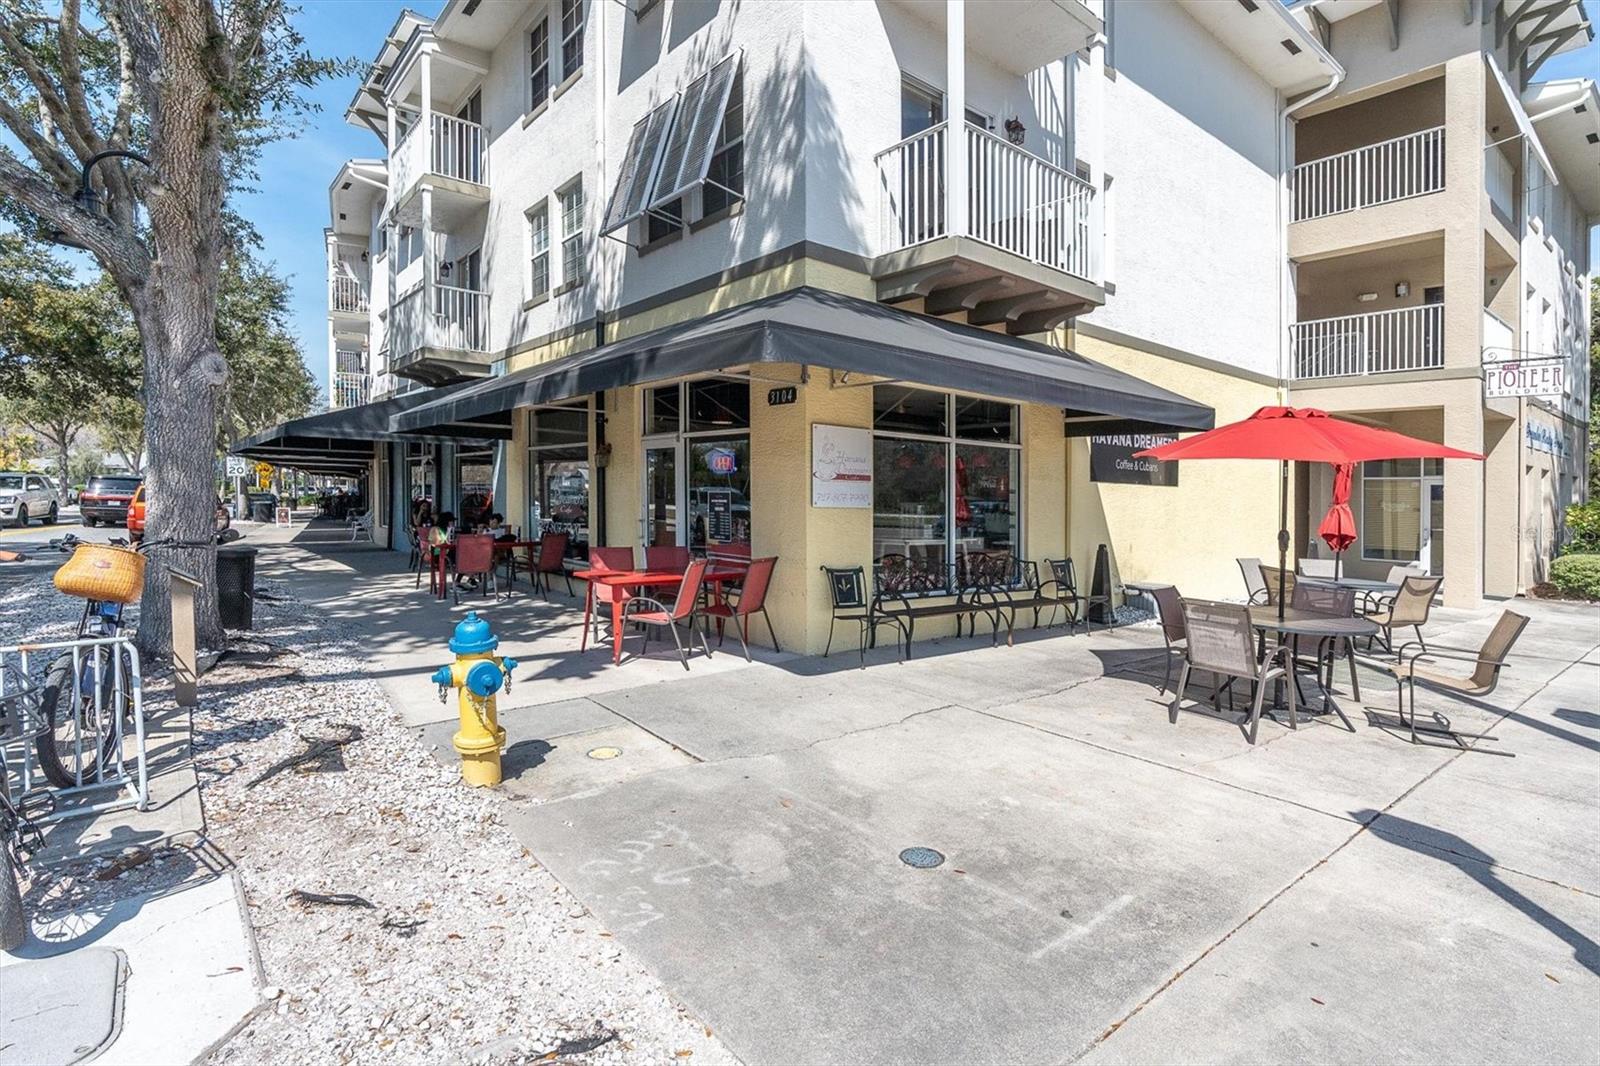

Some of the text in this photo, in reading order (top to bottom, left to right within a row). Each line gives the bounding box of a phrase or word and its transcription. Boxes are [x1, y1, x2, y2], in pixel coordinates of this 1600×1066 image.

[1488, 367, 1561, 390] PIONEER
[770, 389, 793, 403] 3104
[1489, 387, 1560, 395] BUILDING
[1134, 434, 1176, 448] DREAM
[229, 466, 244, 474] 20
[1115, 459, 1133, 470] Coffee
[1134, 461, 1138, 470] &
